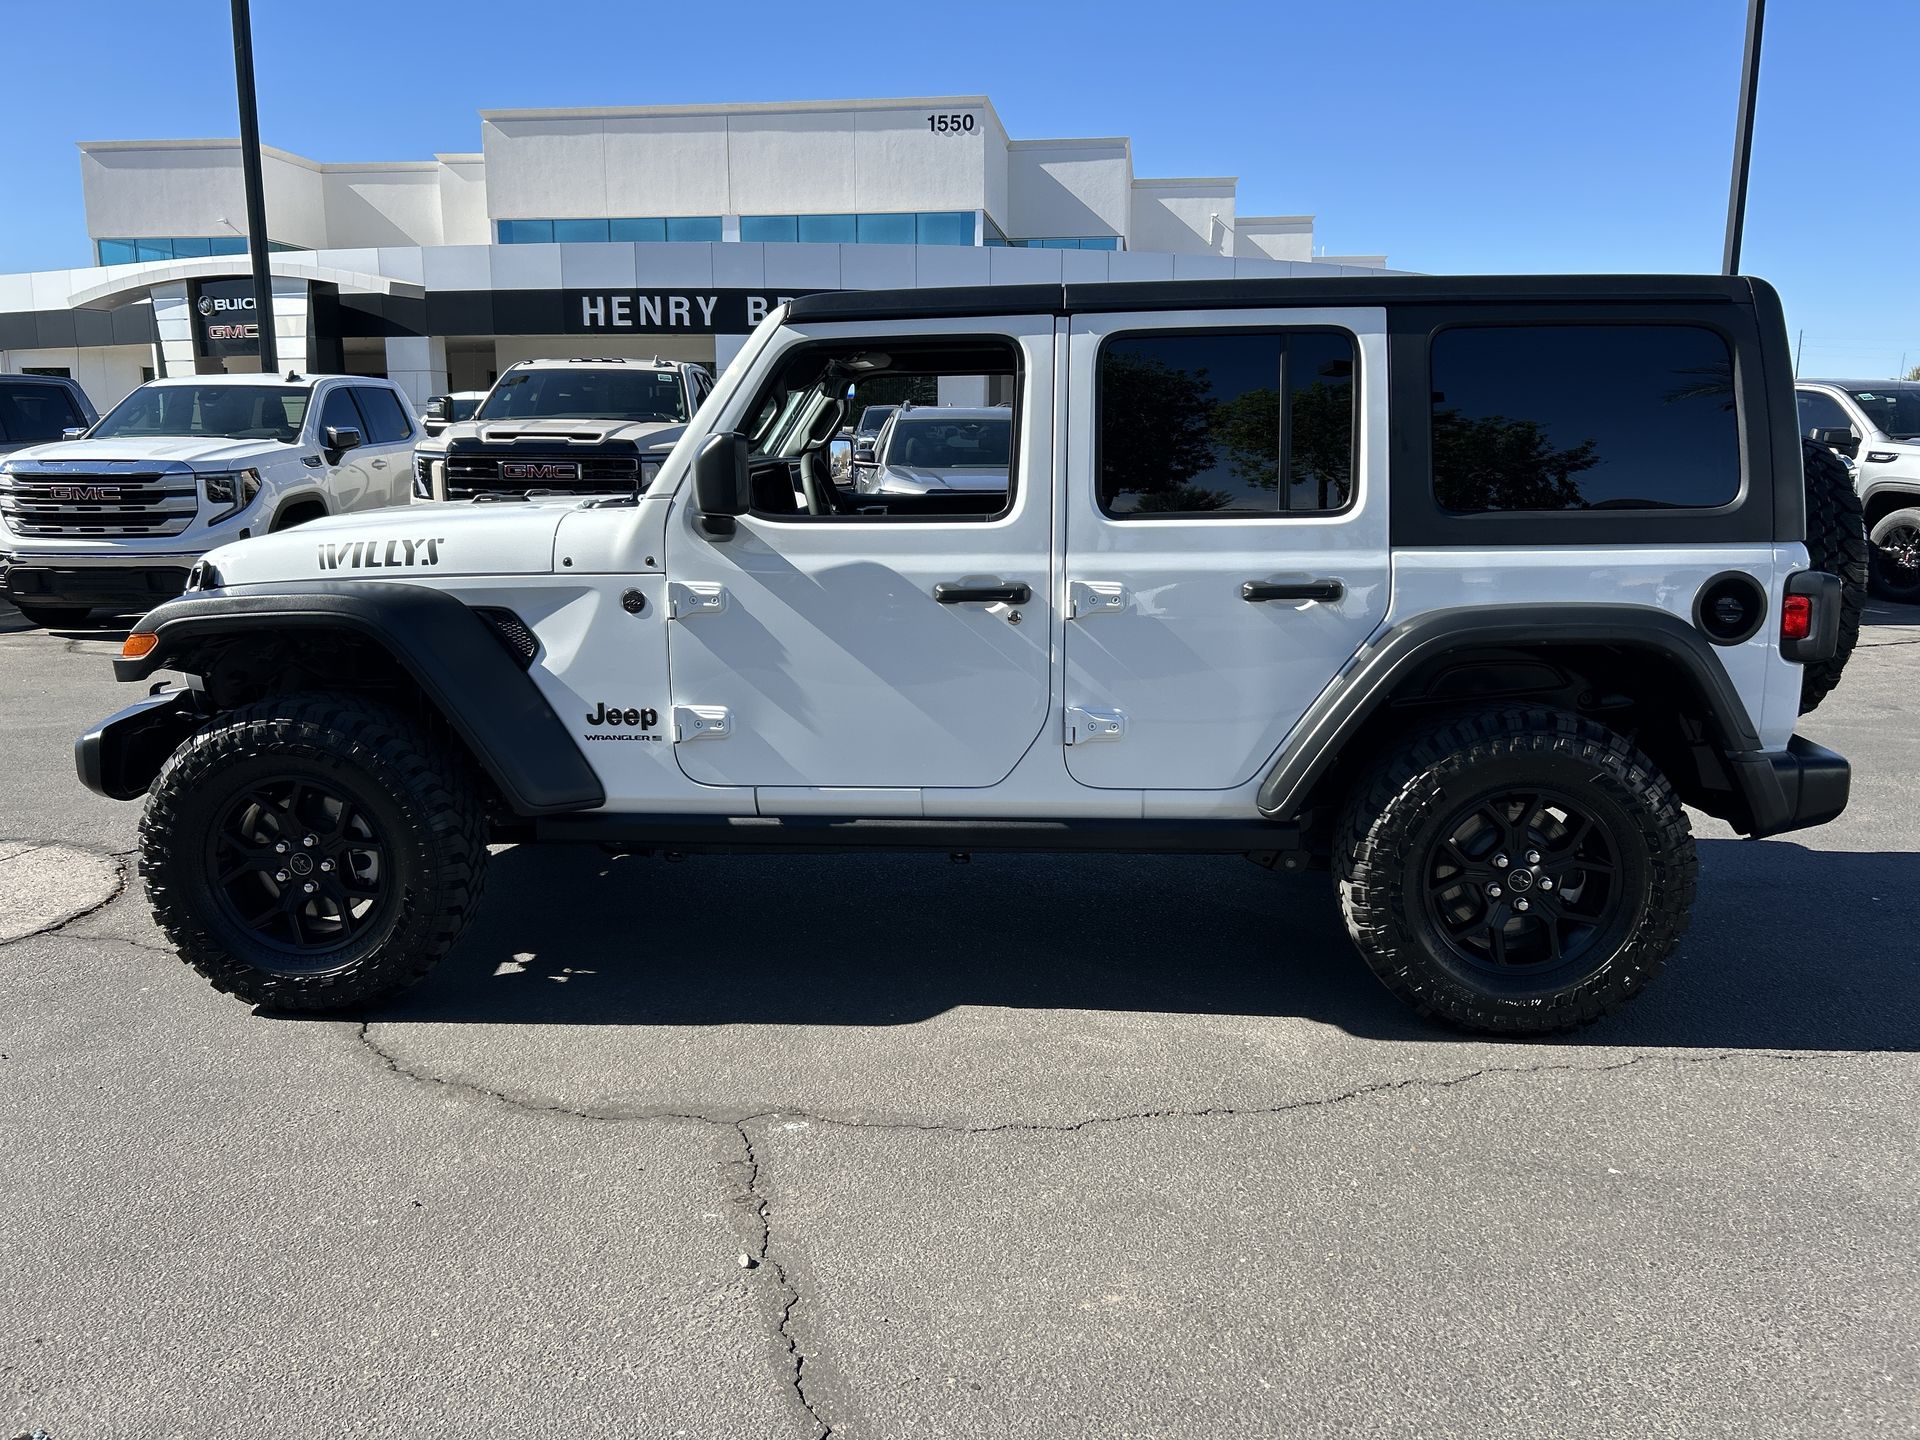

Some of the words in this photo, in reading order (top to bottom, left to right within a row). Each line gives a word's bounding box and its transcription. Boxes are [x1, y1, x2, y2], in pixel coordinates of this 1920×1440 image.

[927, 114, 974, 132] 1550
[214, 297, 257, 311] BUIC
[581, 296, 718, 326] HENRY
[746, 296, 796, 326] B
[209, 324, 259, 339] GMC
[503, 464, 576, 479] GMC
[50, 486, 121, 500] GMC
[318, 538, 445, 570] WILLYS
[586, 702, 658, 731] Jeep
